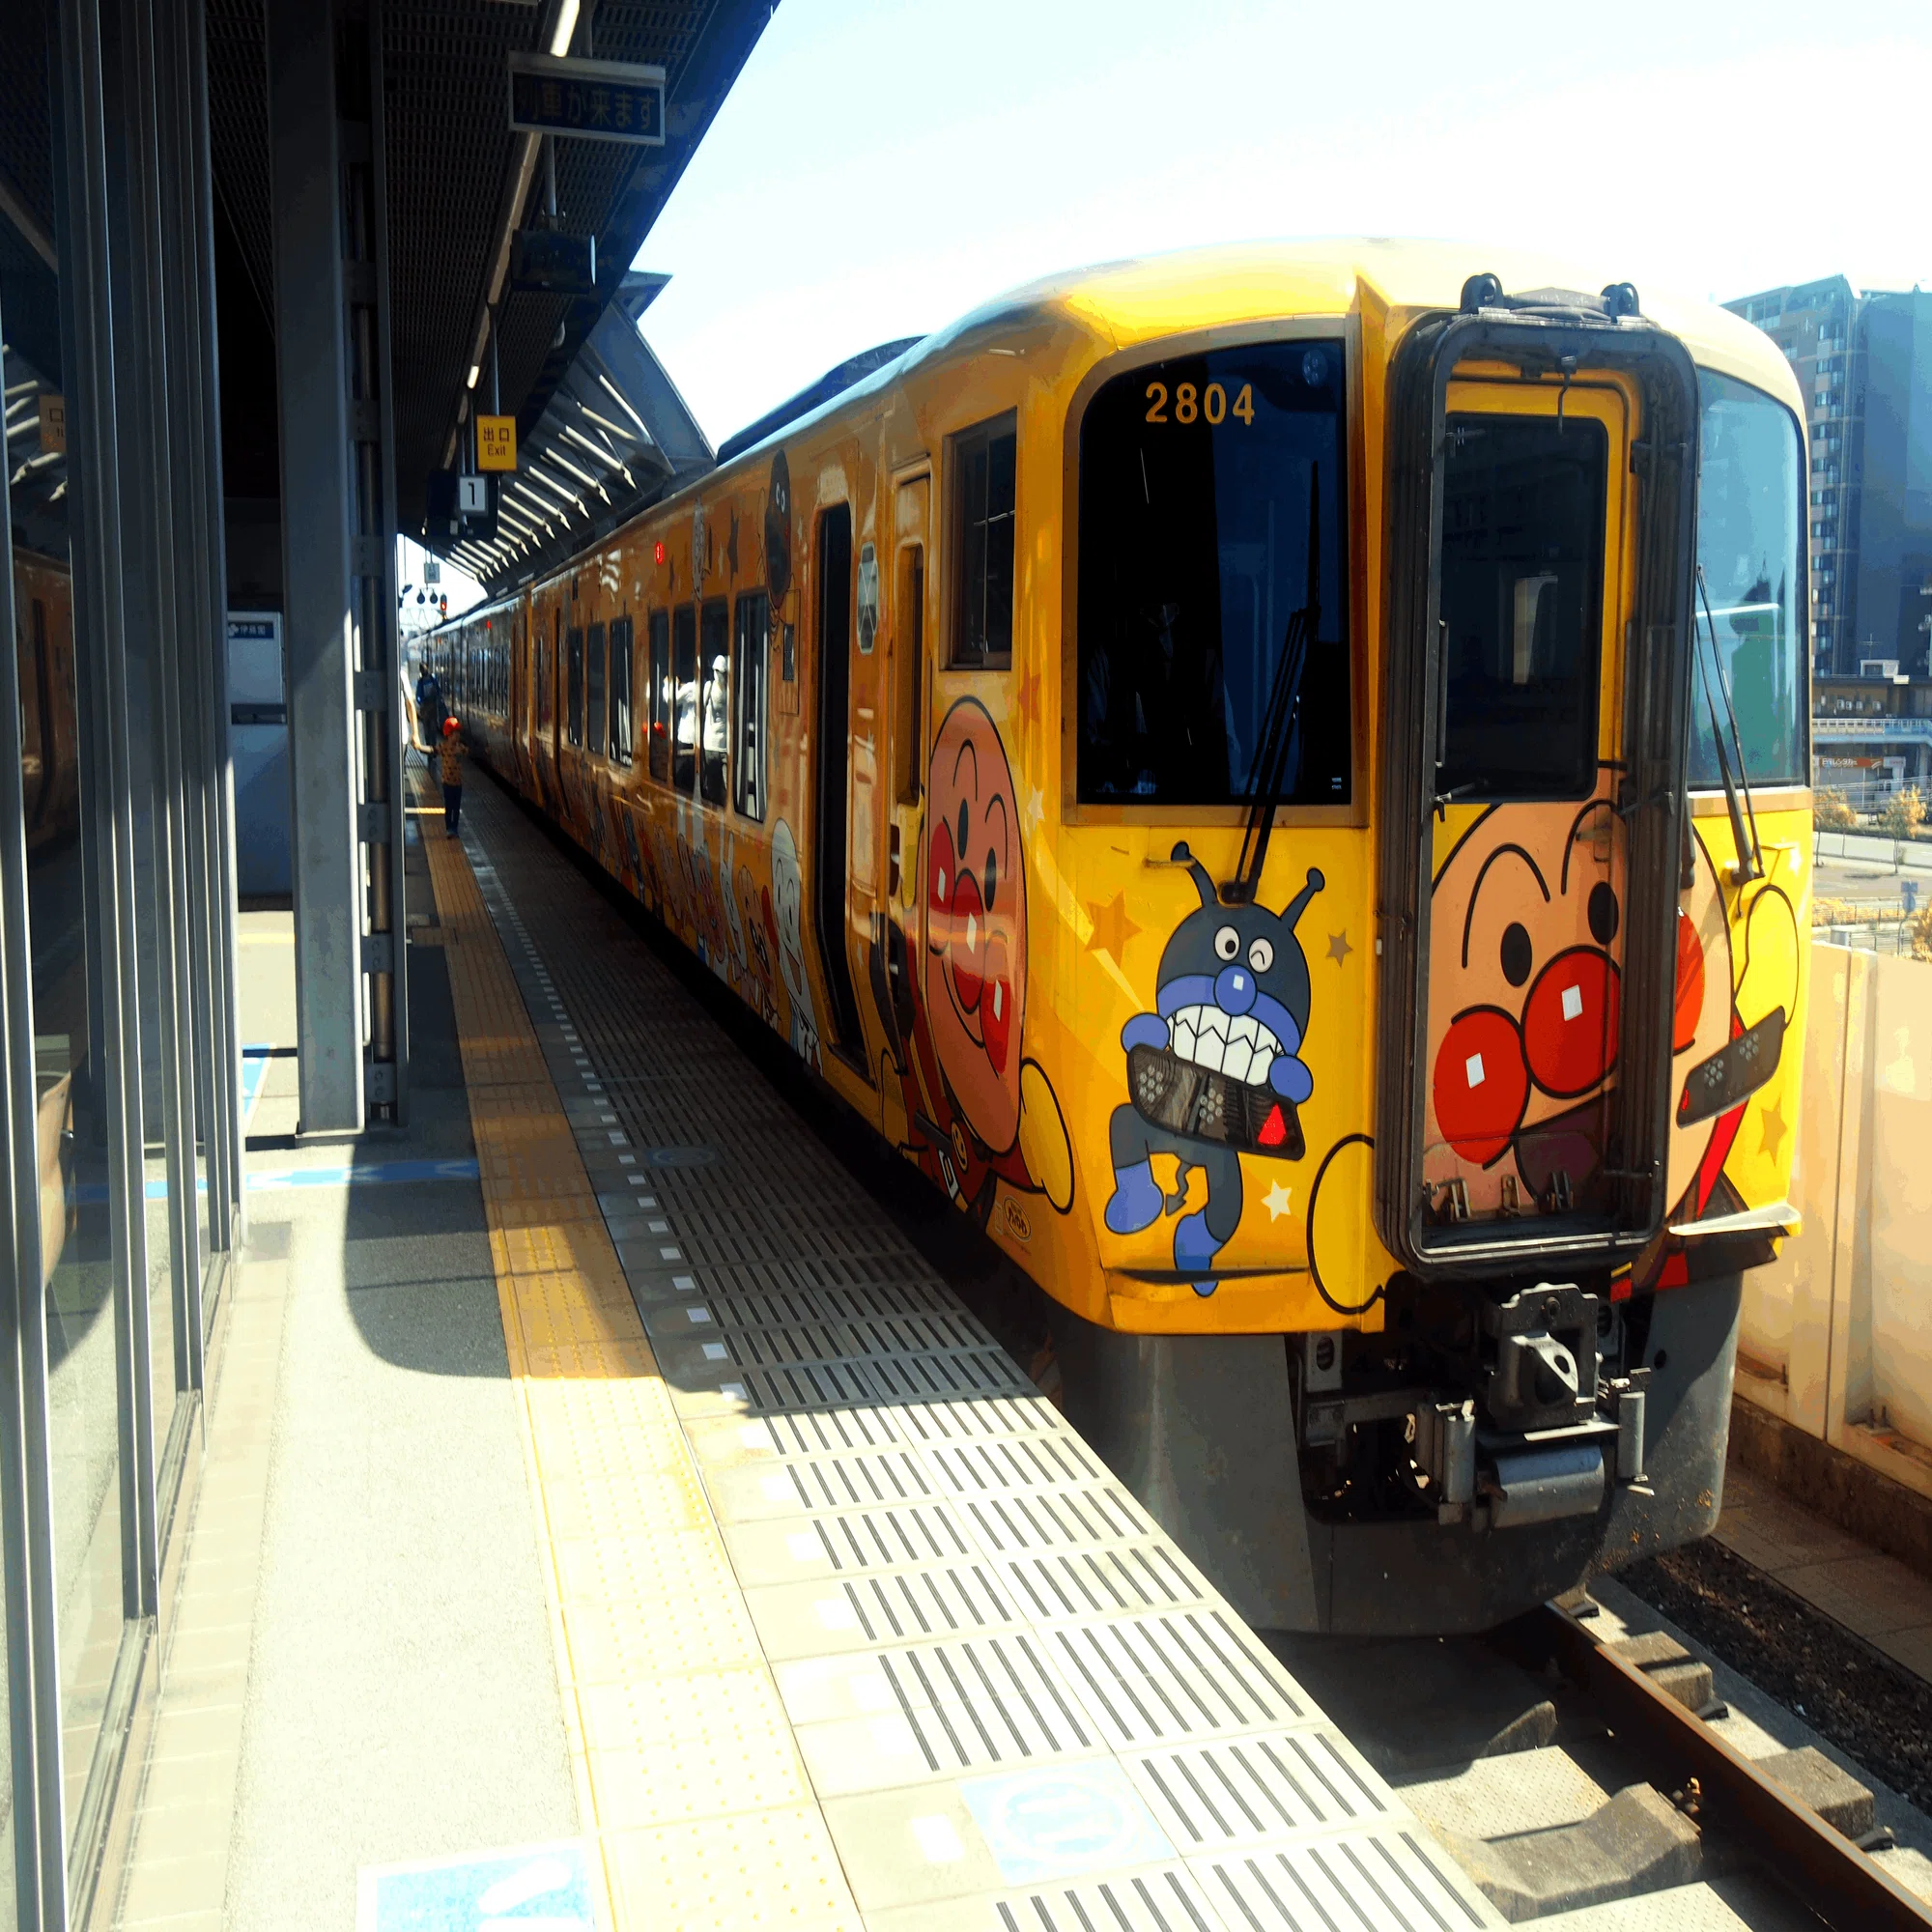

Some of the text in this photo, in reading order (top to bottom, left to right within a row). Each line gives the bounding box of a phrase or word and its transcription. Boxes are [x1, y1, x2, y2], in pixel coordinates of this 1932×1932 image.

[1145, 382, 1256, 426] 2804
[483, 427, 510, 442] 出口
[487, 443, 506, 457] Exit
[468, 481, 475, 506] 1
